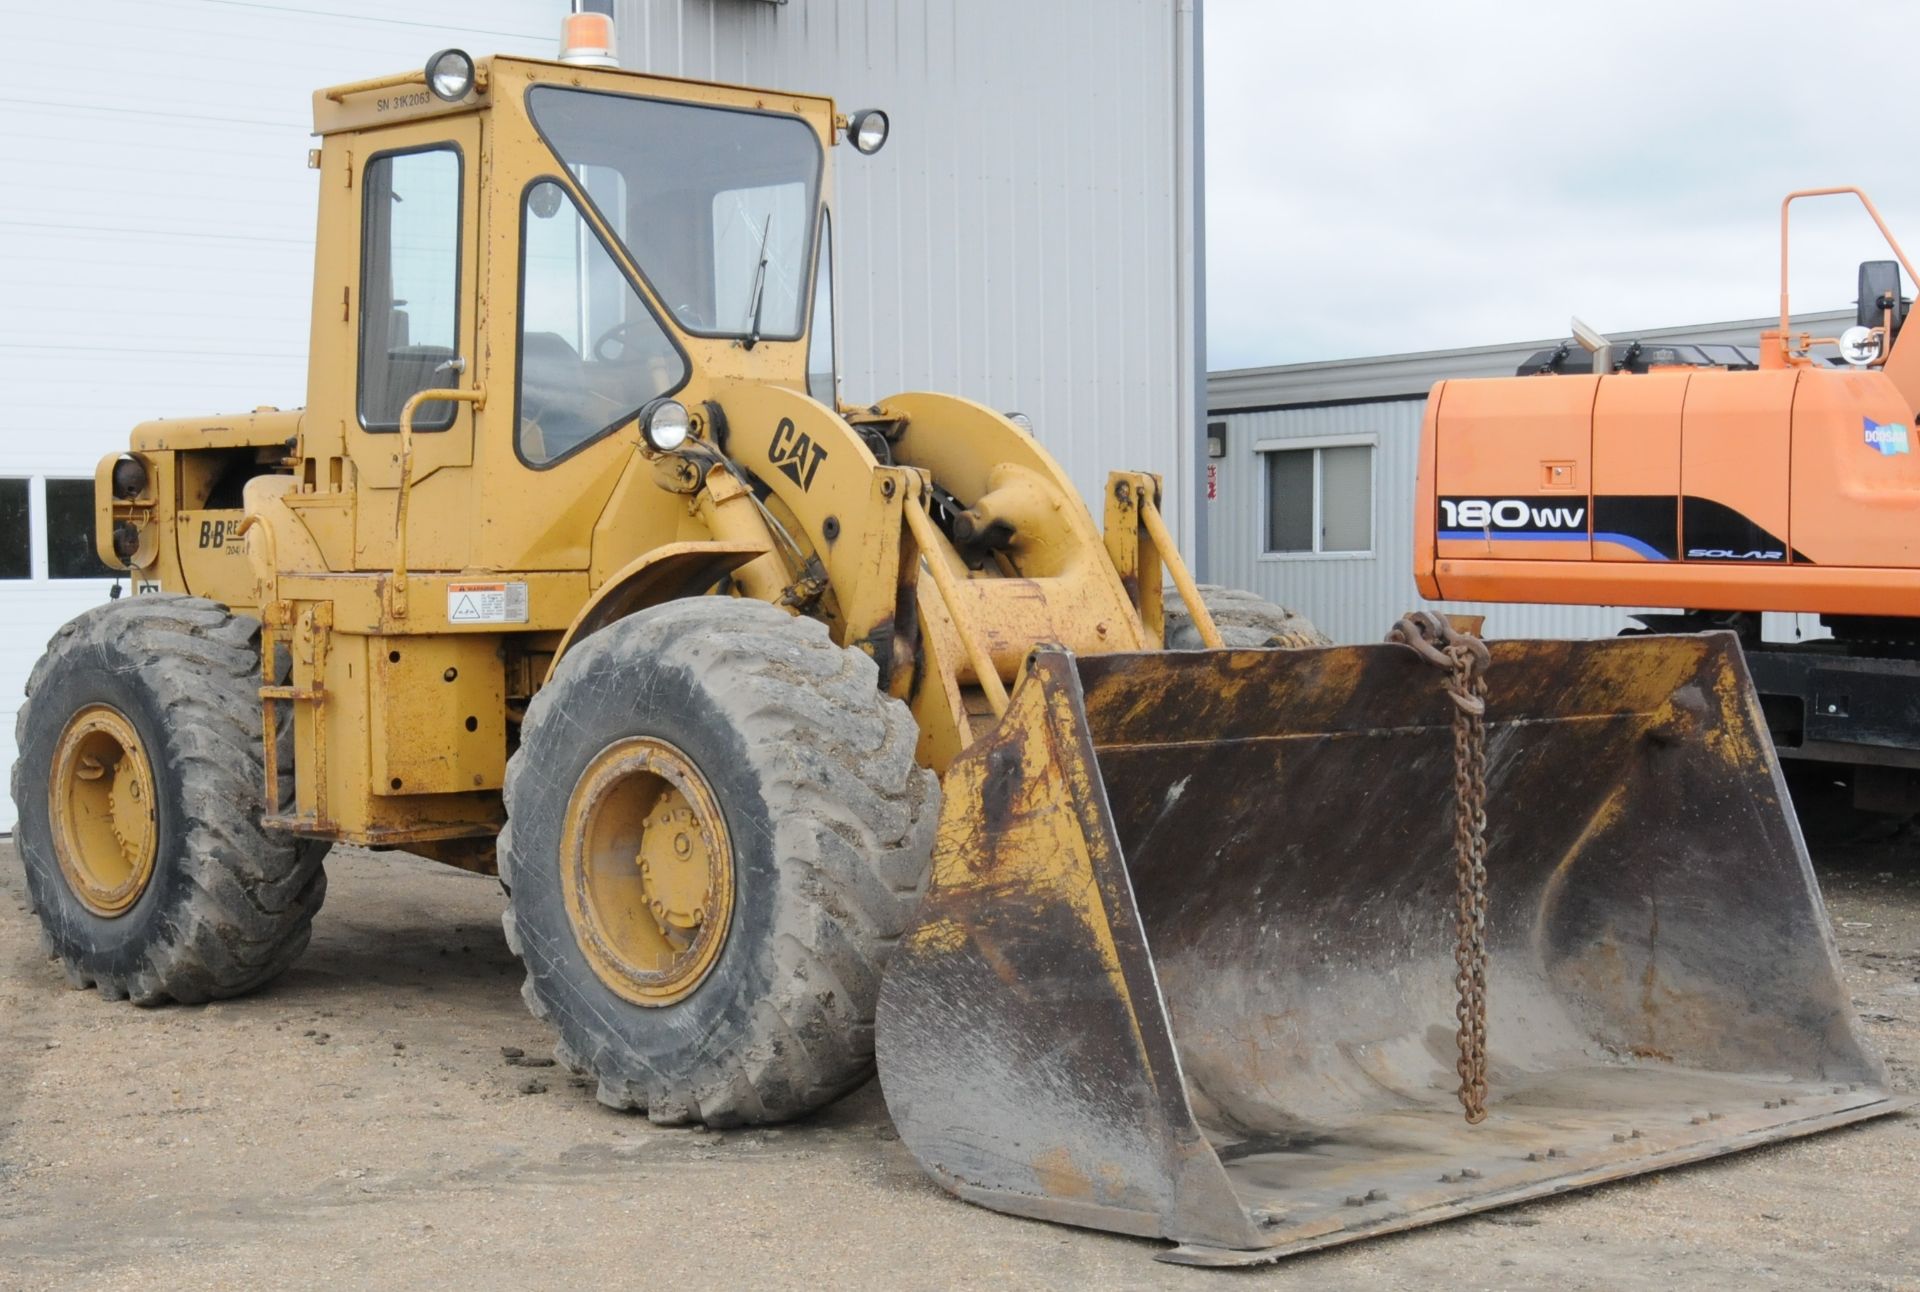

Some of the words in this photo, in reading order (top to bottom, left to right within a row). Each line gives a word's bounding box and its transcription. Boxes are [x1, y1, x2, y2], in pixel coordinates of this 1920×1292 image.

[377, 98, 389, 111] SN
[768, 416, 828, 494] CAT
[1687, 548, 1784, 560] SOLAR
